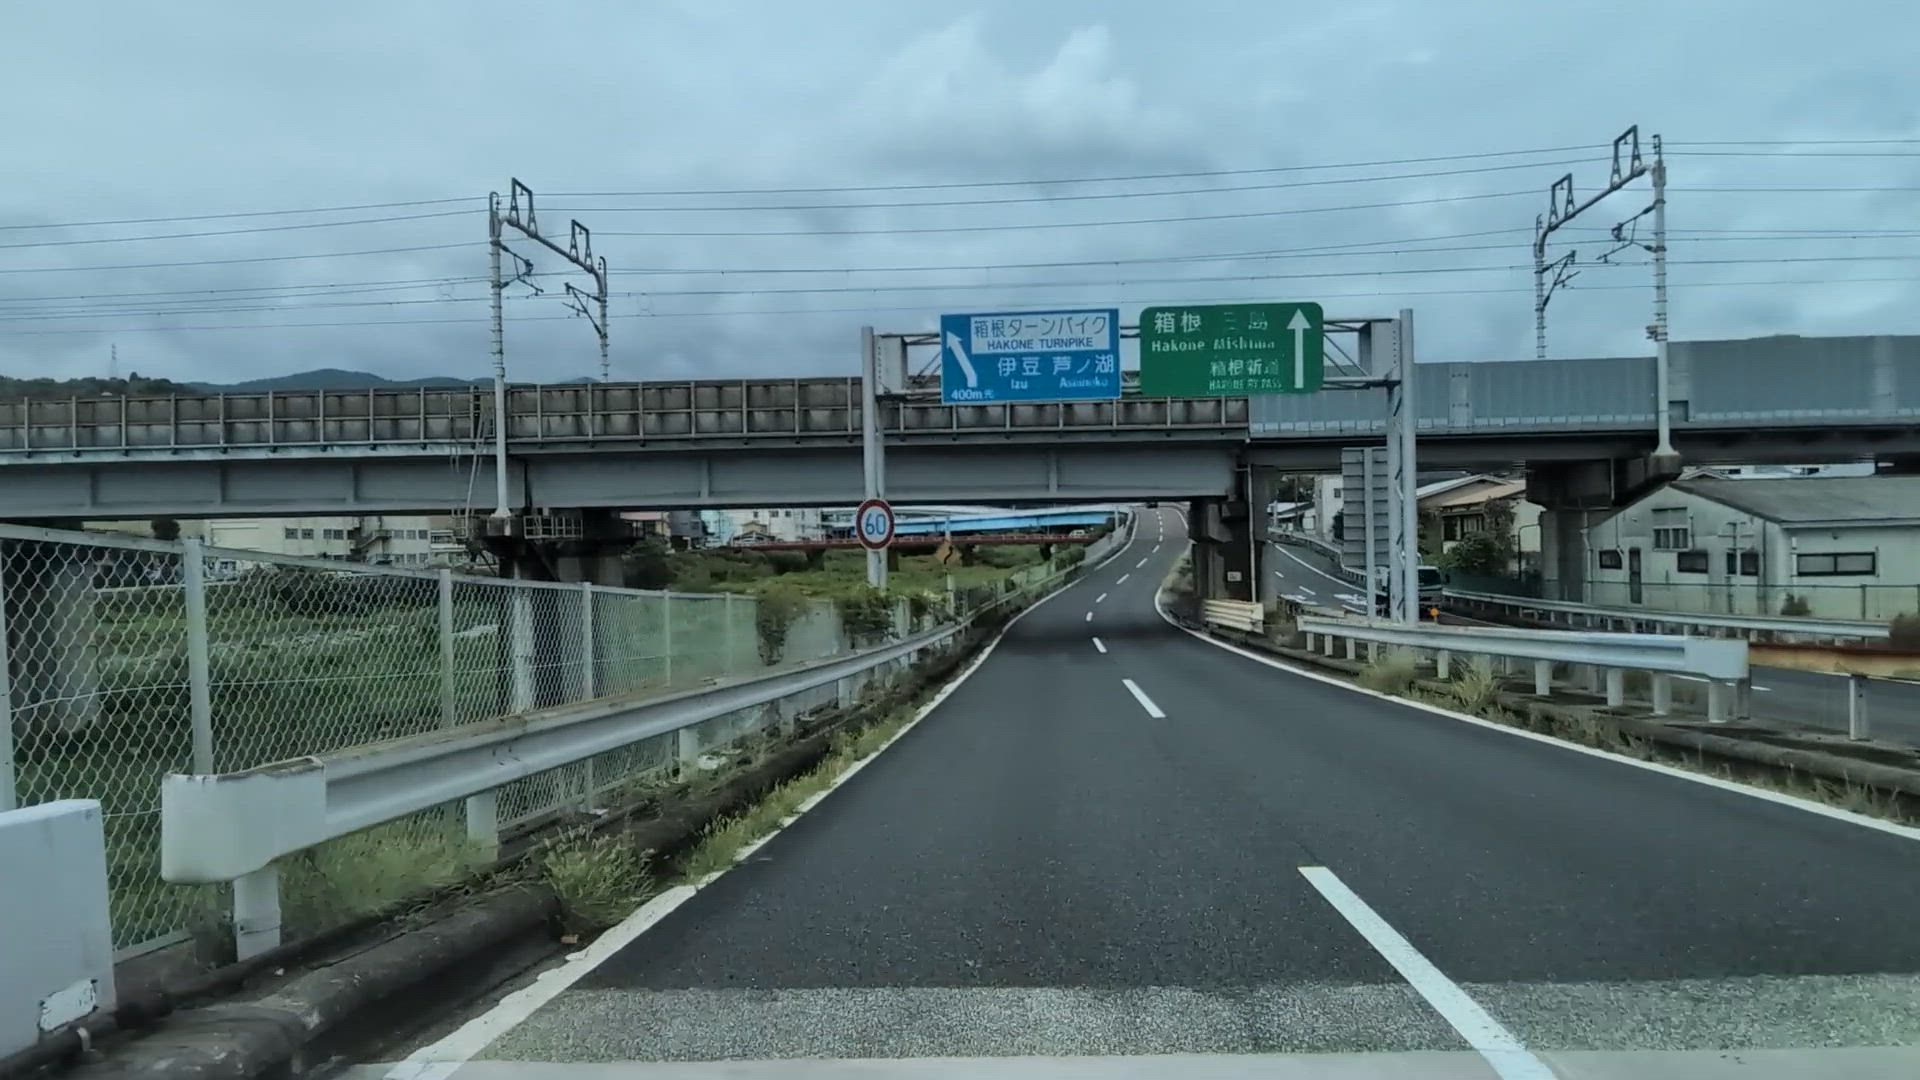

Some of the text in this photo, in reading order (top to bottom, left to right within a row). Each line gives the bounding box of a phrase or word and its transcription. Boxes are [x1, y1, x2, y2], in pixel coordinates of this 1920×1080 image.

[1154, 311, 1202, 334] 箱根
[987, 337, 1093, 350] HAKONE TURNPIKE
[1151, 340, 1205, 352] Hakone
[998, 354, 1114, 377] 伊豆 芦ノ湖
[1011, 378, 1028, 389] Izu
[865, 513, 886, 535] 60
